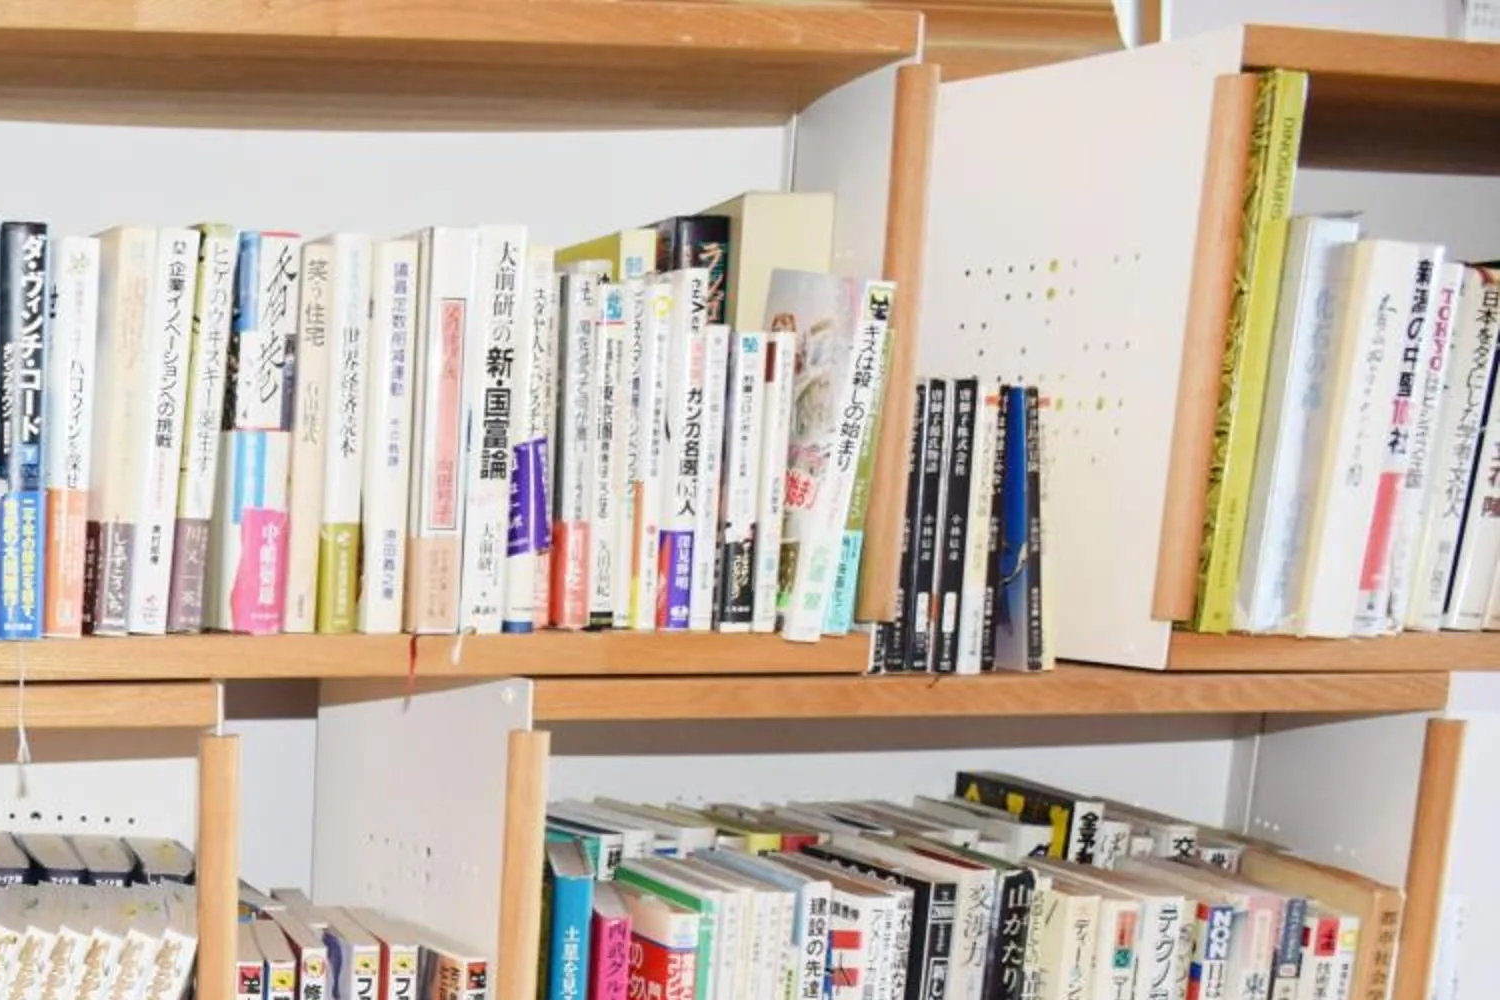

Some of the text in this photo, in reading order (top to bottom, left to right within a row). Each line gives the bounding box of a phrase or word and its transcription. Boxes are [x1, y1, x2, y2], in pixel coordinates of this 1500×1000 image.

[19, 233, 47, 439] ダ・ヴィンチ・コード
[304, 259, 329, 347] 笑う住宅
[480, 240, 517, 480] 大前研一の新・国富論
[836, 325, 883, 473] キスは殺しの始まり
[803, 896, 828, 999] 建設の先達
[1001, 885, 1032, 992] 山がたり
[1207, 909, 1233, 959] NON
